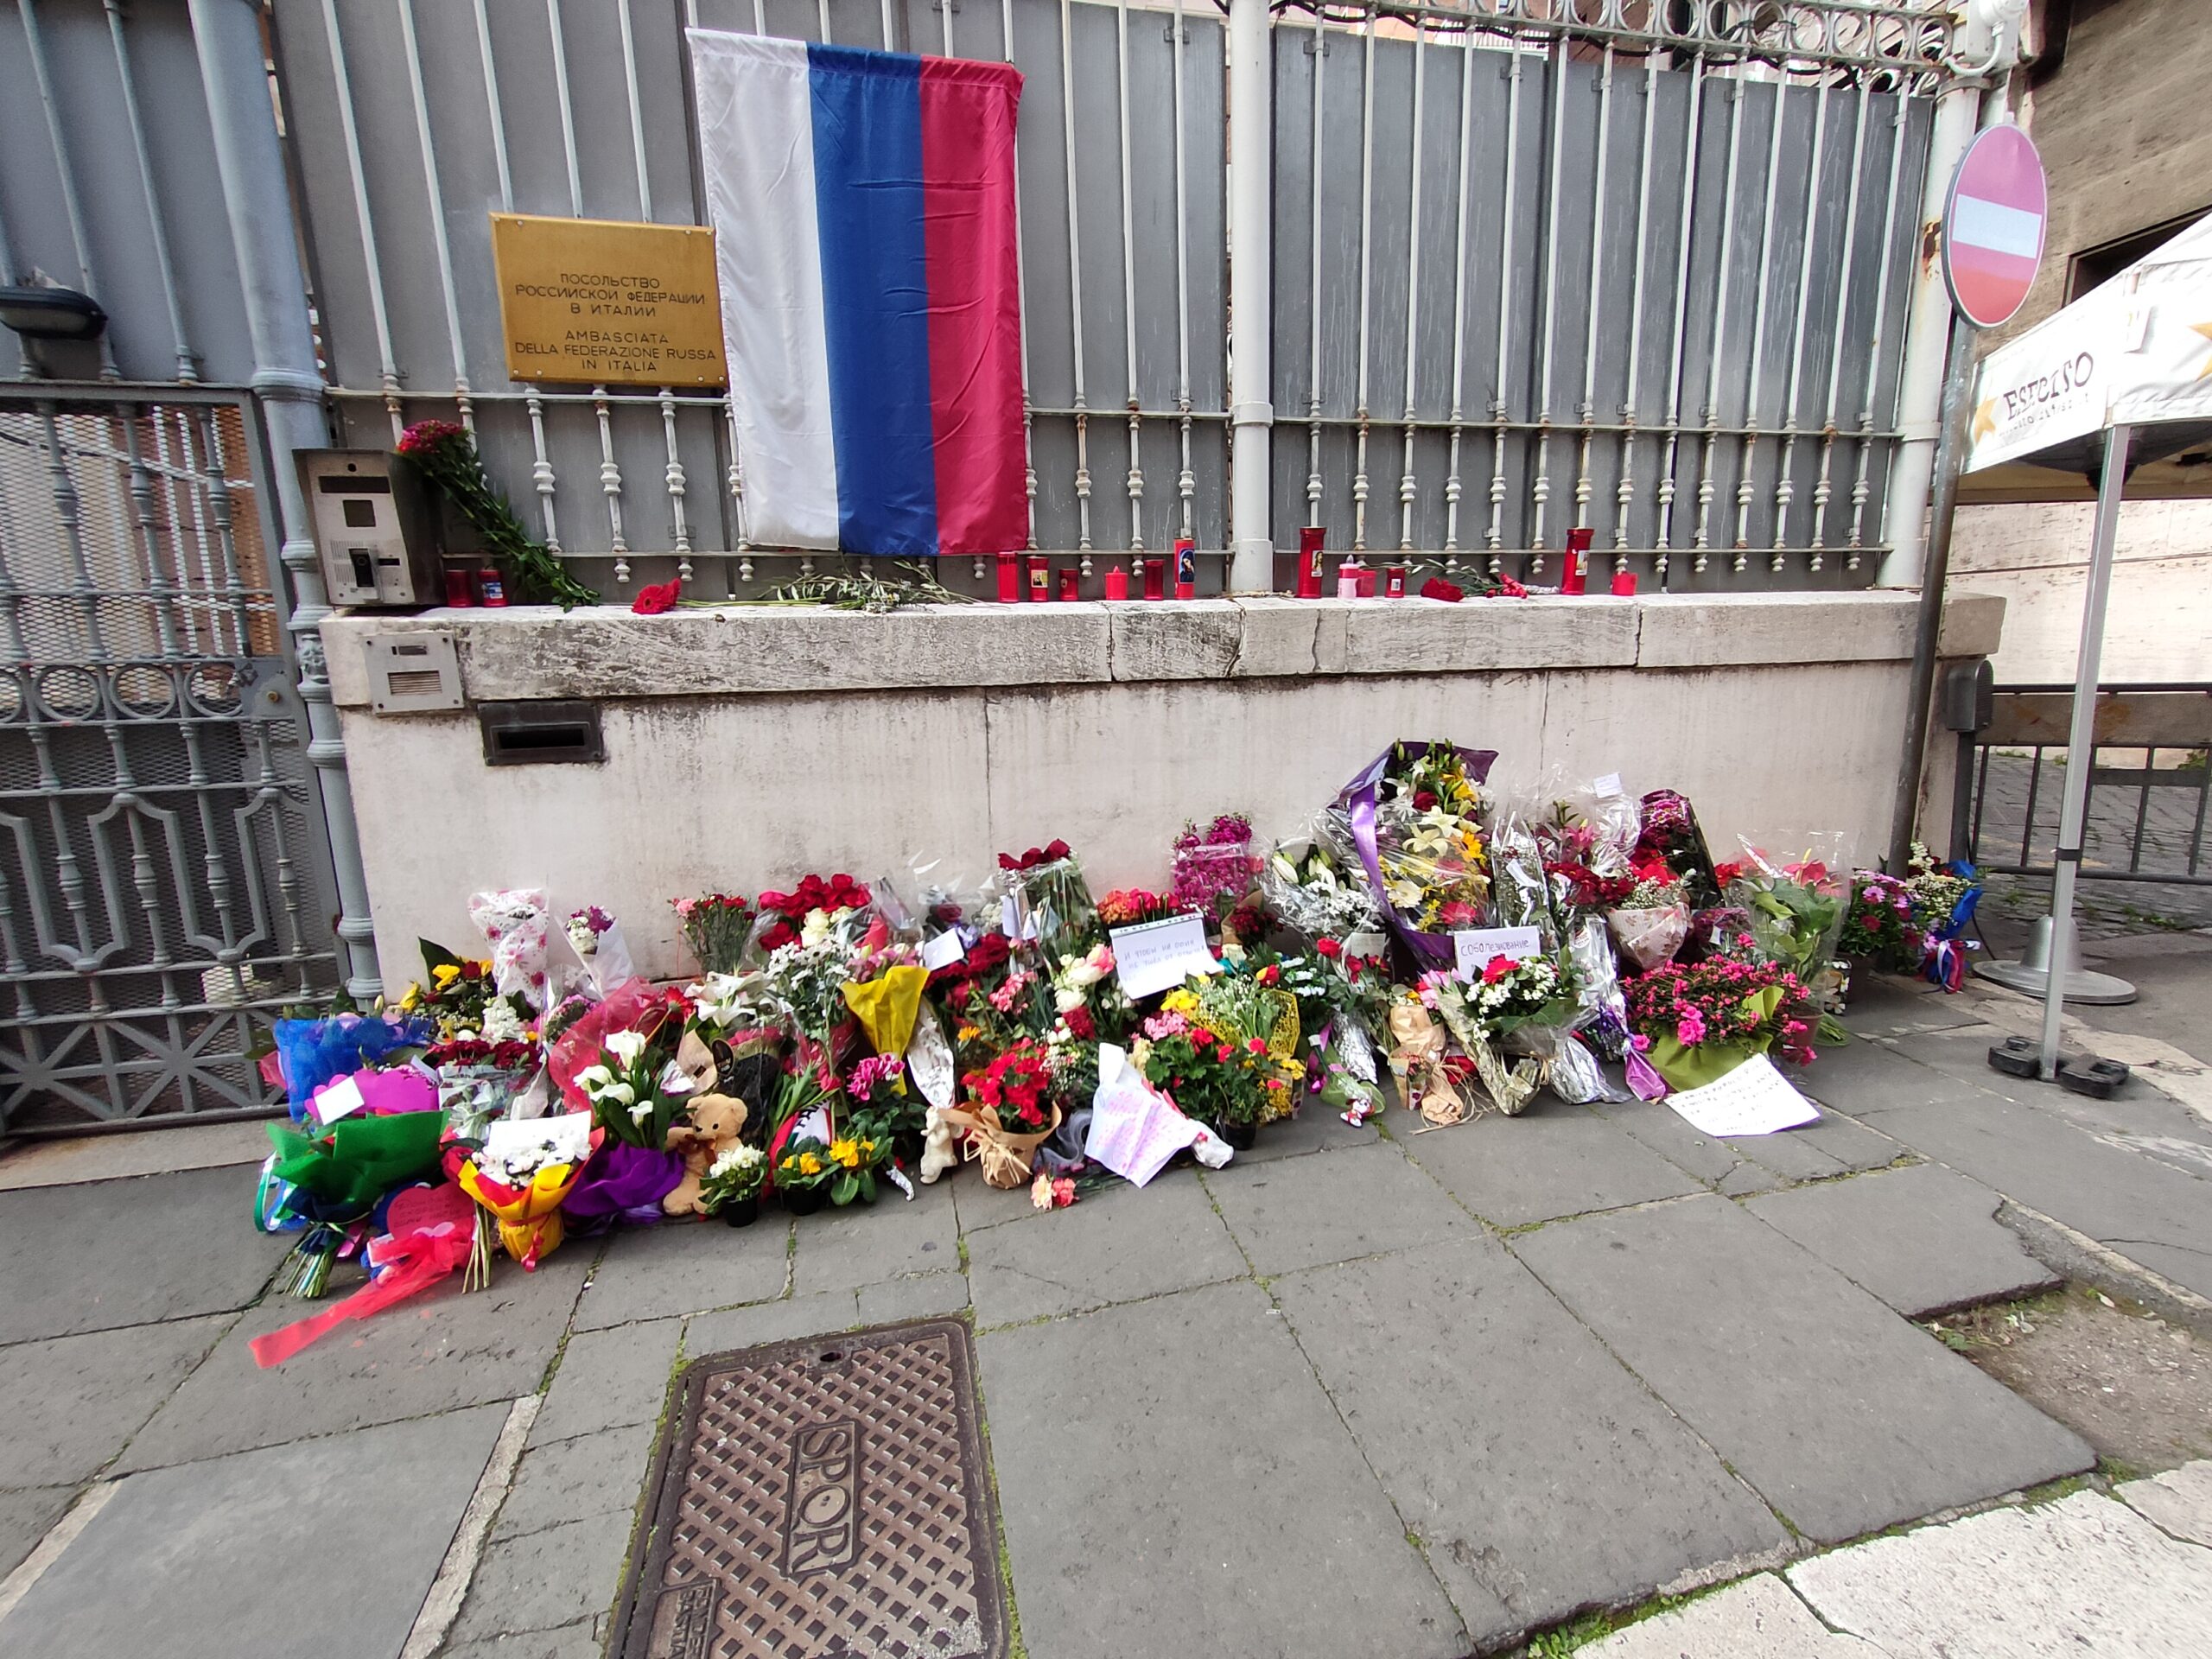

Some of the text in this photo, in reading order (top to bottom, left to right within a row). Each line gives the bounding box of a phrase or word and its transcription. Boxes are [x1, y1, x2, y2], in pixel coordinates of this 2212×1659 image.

[561, 273, 660, 289] ПОСОЛЬСТВО
[627, 292, 705, 304] ФЕДЕРАЦИИ
[570, 304, 656, 317] В ИТАЛИИ
[565, 330, 669, 344] AMBASCIATA
[515, 342, 716, 360] DELLA FEDERAZIONE RUSSA
[582, 359, 657, 372] IN ITALIA
[791, 1430, 851, 1573] SPQR
